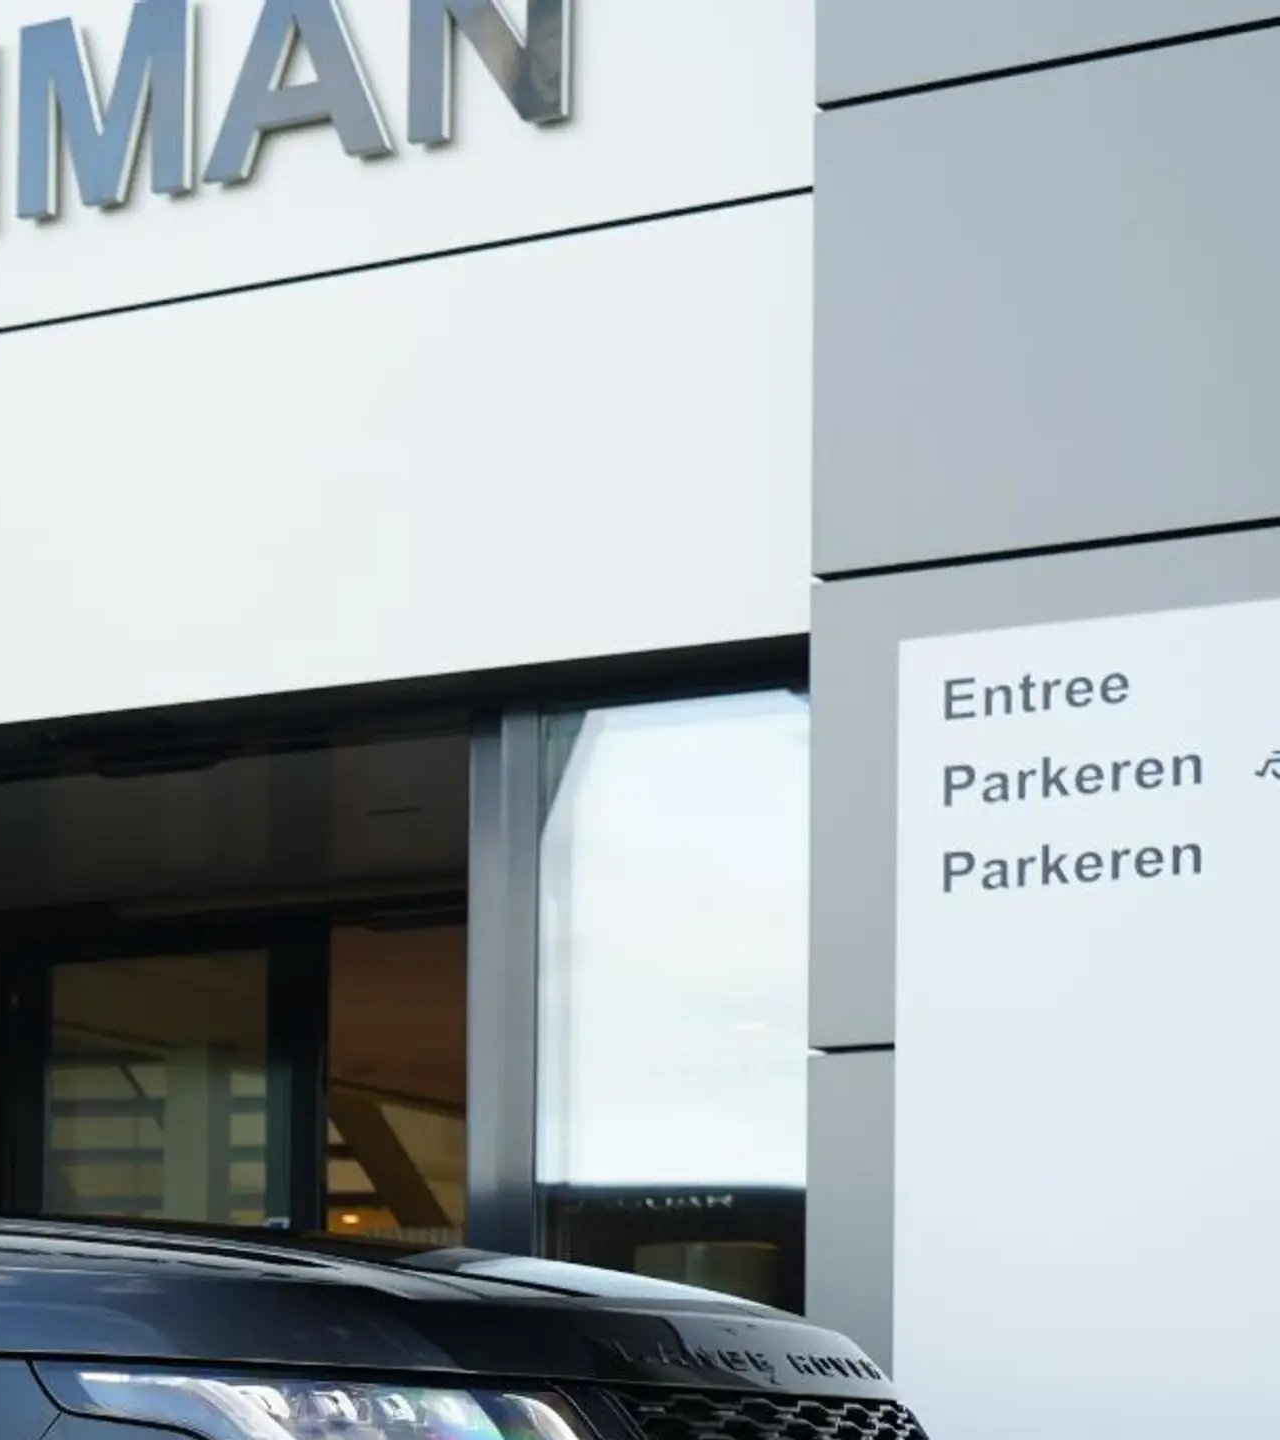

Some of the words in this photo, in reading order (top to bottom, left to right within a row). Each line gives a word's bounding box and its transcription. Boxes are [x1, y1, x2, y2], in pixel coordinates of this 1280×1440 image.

[943, 671, 1131, 722] Entree
[942, 751, 1204, 808] Parkeren
[942, 841, 1204, 894] Parkeren
